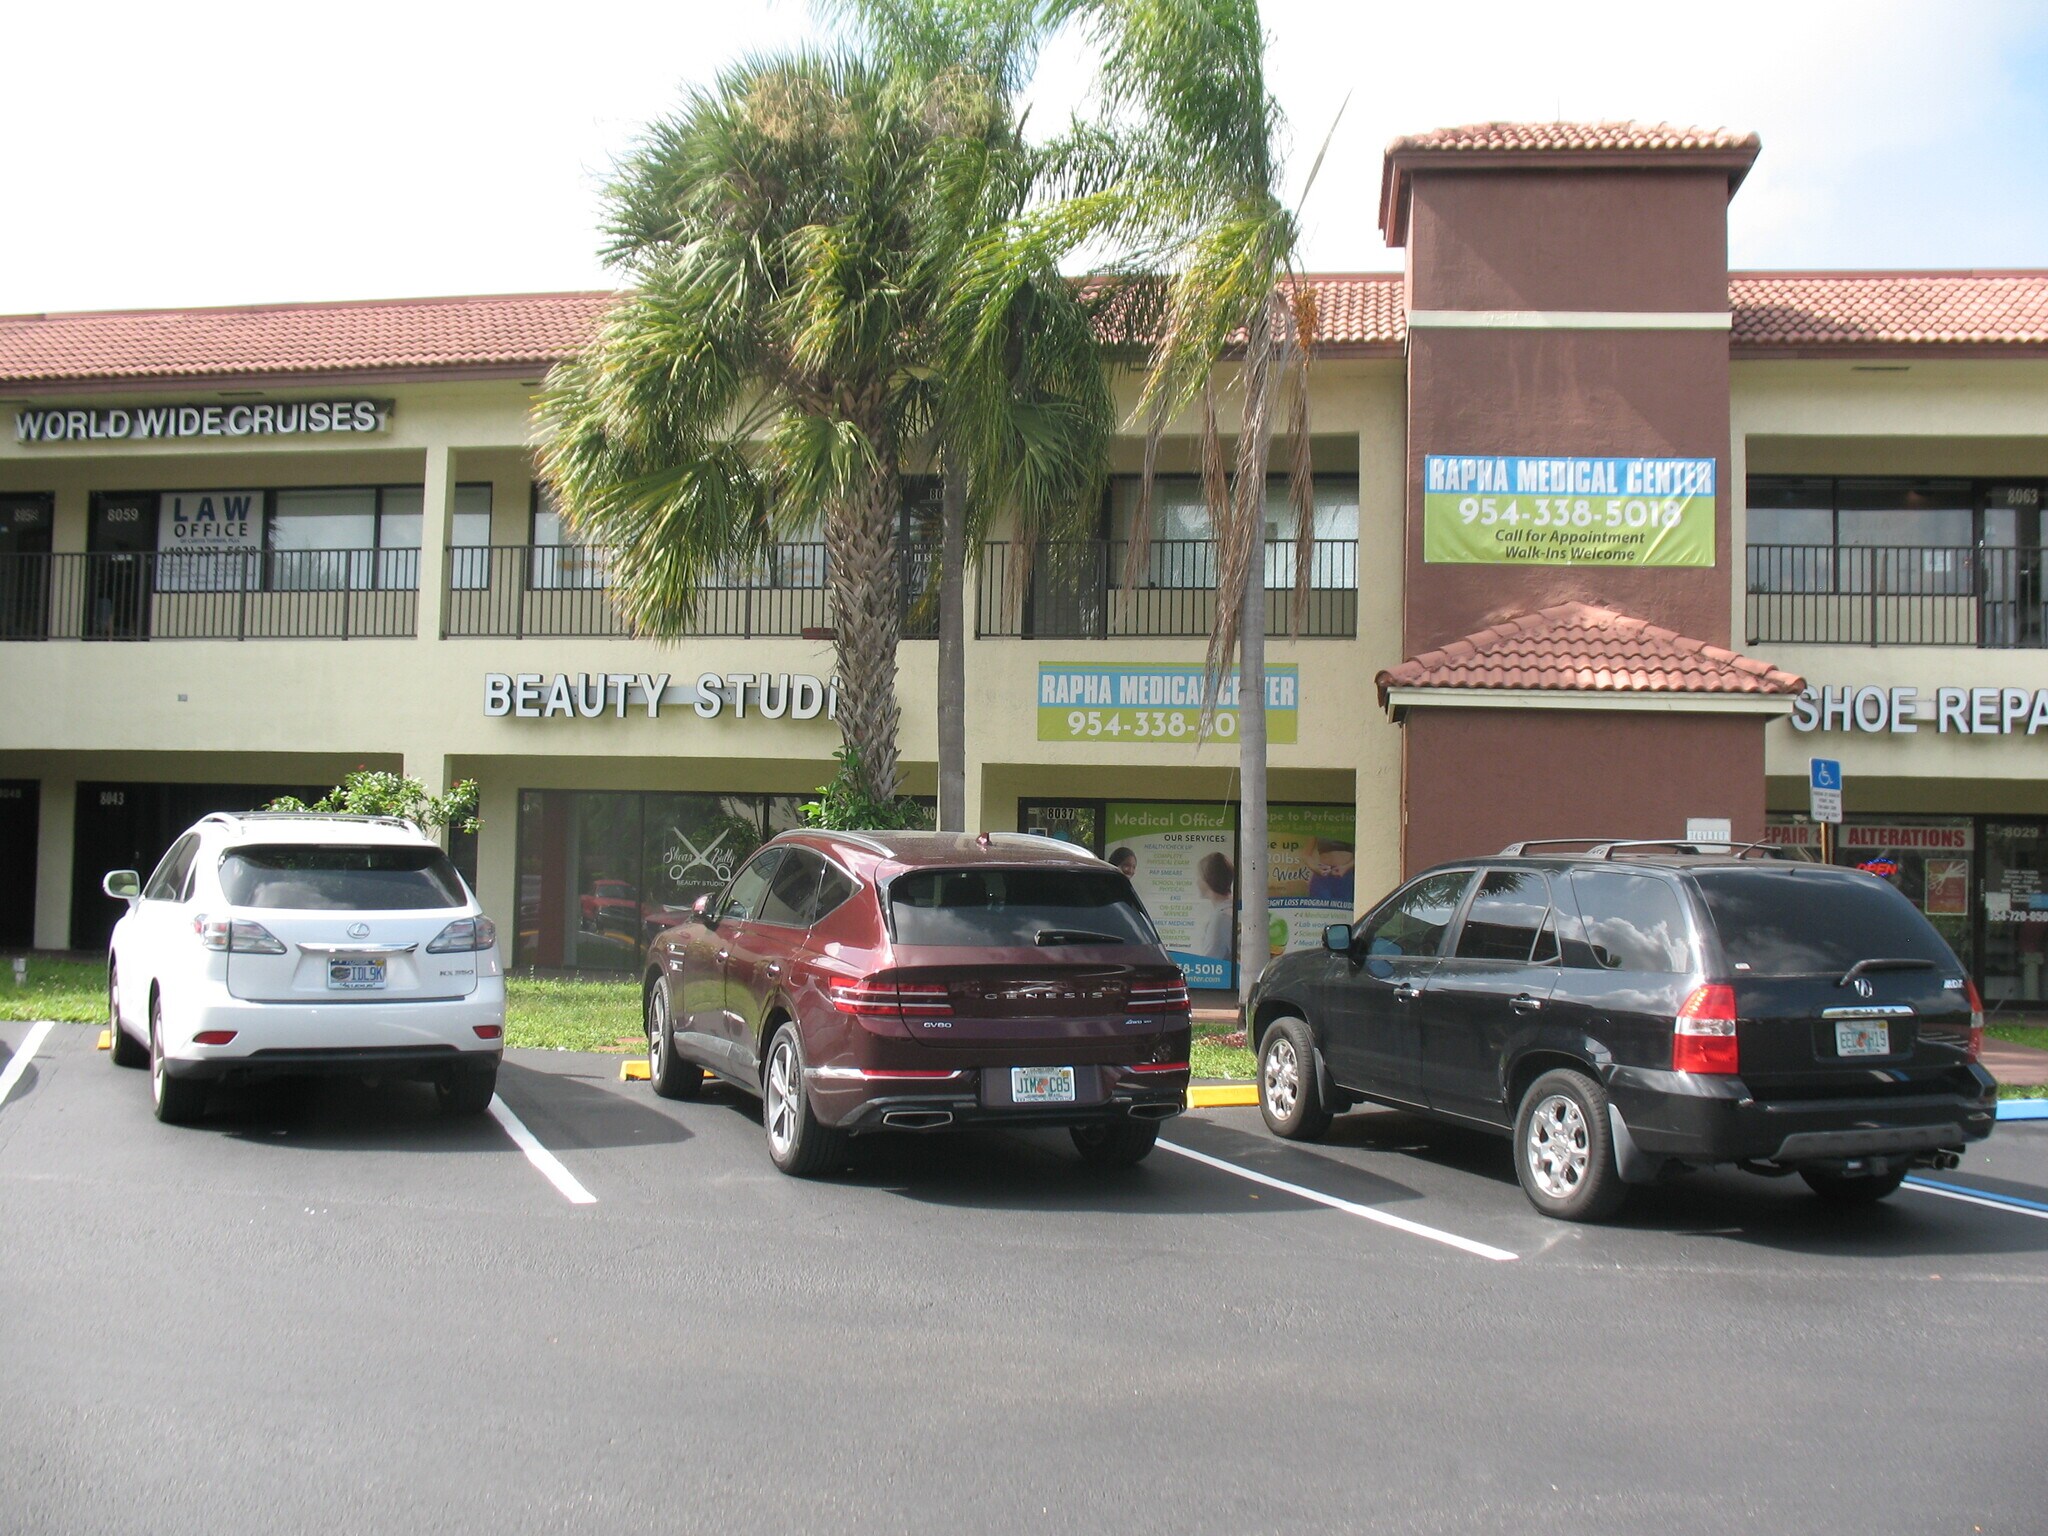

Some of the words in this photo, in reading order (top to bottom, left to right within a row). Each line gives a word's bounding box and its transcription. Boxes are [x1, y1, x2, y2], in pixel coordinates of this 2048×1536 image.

[15, 409, 132, 442] WORLD
[137, 406, 224, 438] WIDE
[228, 400, 378, 435] CRUISES
[1429, 458, 1508, 491] RAPHA
[1517, 460, 1618, 493] MEDICAL
[1626, 461, 1712, 493] CENTER
[2007, 488, 2039, 504] 8063
[107, 508, 139, 521] 8059
[173, 496, 251, 522] LAW
[1459, 498, 1682, 528] 954-338-5018
[174, 522, 247, 538] OFFICE
[1495, 529, 1523, 542] Call
[1525, 529, 1547, 543] for
[1549, 530, 1645, 547] Appointment
[1505, 546, 1567, 560] Walk-Ins
[1570, 547, 1635, 560] Welcome
[484, 673, 670, 718] BEAUTY
[693, 673, 842, 719] STUDI
[1042, 675, 1112, 704] RAPHA
[1217, 676, 1295, 706] CETER
[1791, 685, 1918, 733] SHOE
[1067, 711, 1241, 737] 954-338-50
[100, 792, 124, 805] 8043
[1048, 808, 1074, 819] 8037
[1114, 812, 1174, 826] Medical
[1180, 813, 1224, 827] Office
[1288, 811, 1300, 821] to
[1304, 810, 1356, 822] Perfectio
[1164, 834, 1183, 842] OUR
[1765, 826, 1808, 845] EPAIR
[1848, 828, 1965, 847] ALTERATIONS
[2004, 827, 2039, 838] 8029
[1282, 842, 1299, 851] up
[1856, 863, 1898, 875] OPEN
[1330, 900, 1353, 908] INCLUD
[352, 967, 383, 981] IDL9K
[984, 991, 1103, 1000] GENESIS
[1017, 1078, 1037, 1094] JIM
